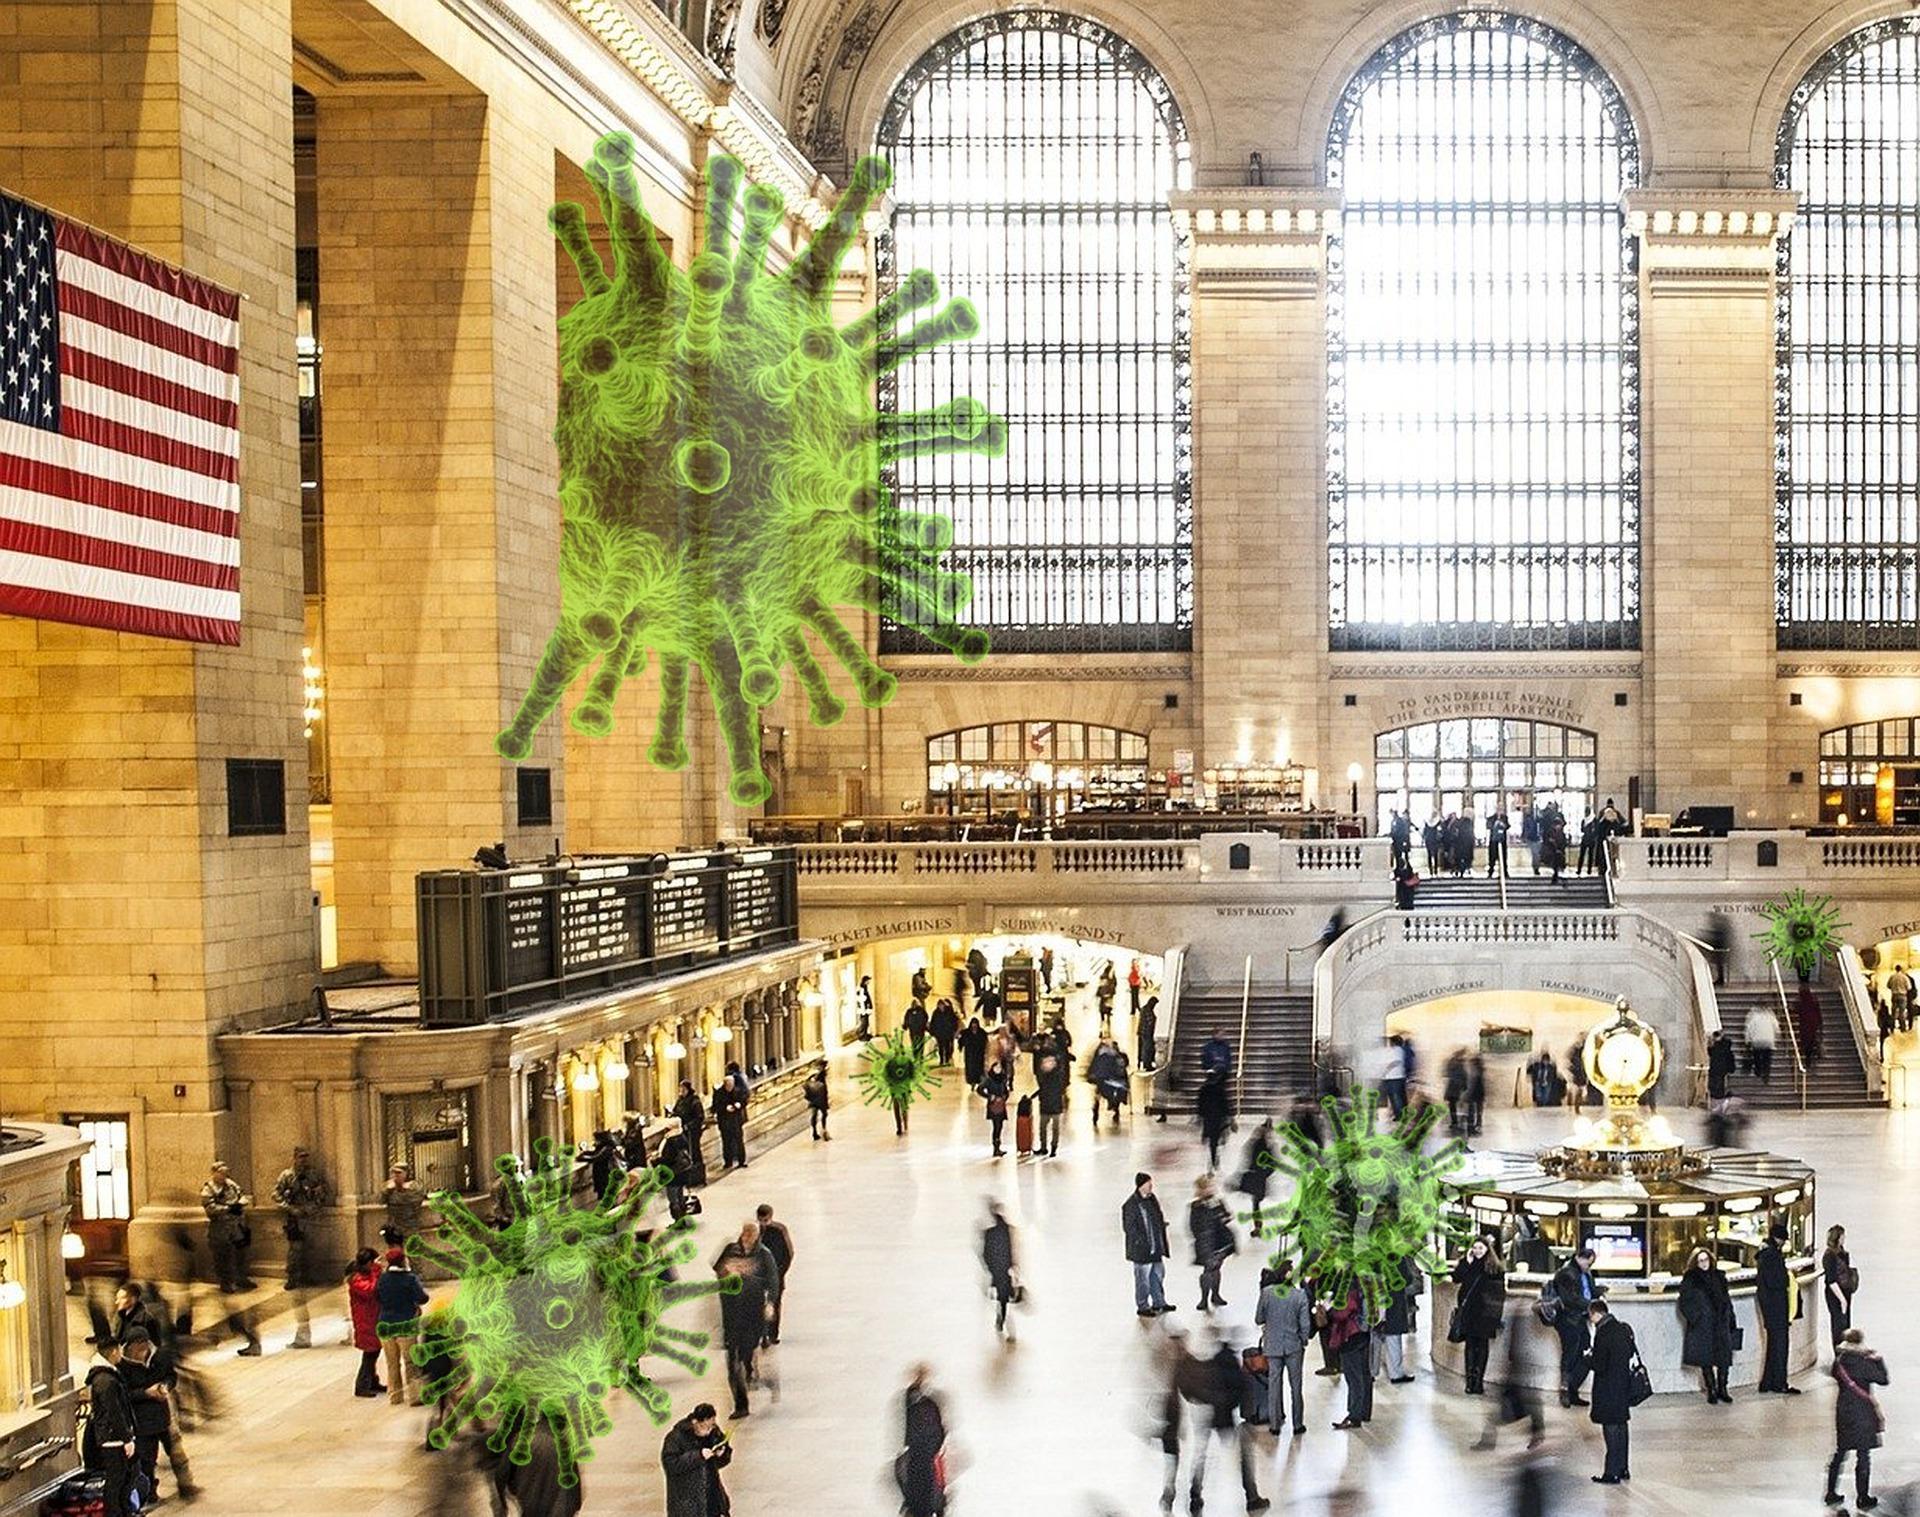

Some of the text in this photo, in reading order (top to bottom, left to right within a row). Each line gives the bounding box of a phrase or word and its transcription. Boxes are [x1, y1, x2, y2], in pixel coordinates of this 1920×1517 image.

[1398, 691, 1574, 710] TO VANDERBILT AVENUE
[1387, 702, 1584, 725] THE CAMPBELL APARTMENT
[1216, 906, 1297, 917] WEST BALCONY
[1713, 904, 1742, 914] WEST
[874, 917, 953, 937] MACHINES
[1000, 919, 1126, 943] SUBWAY 42ND ST
[1391, 990, 1428, 1009] DINING
[1607, 1150, 1664, 1163] Information
